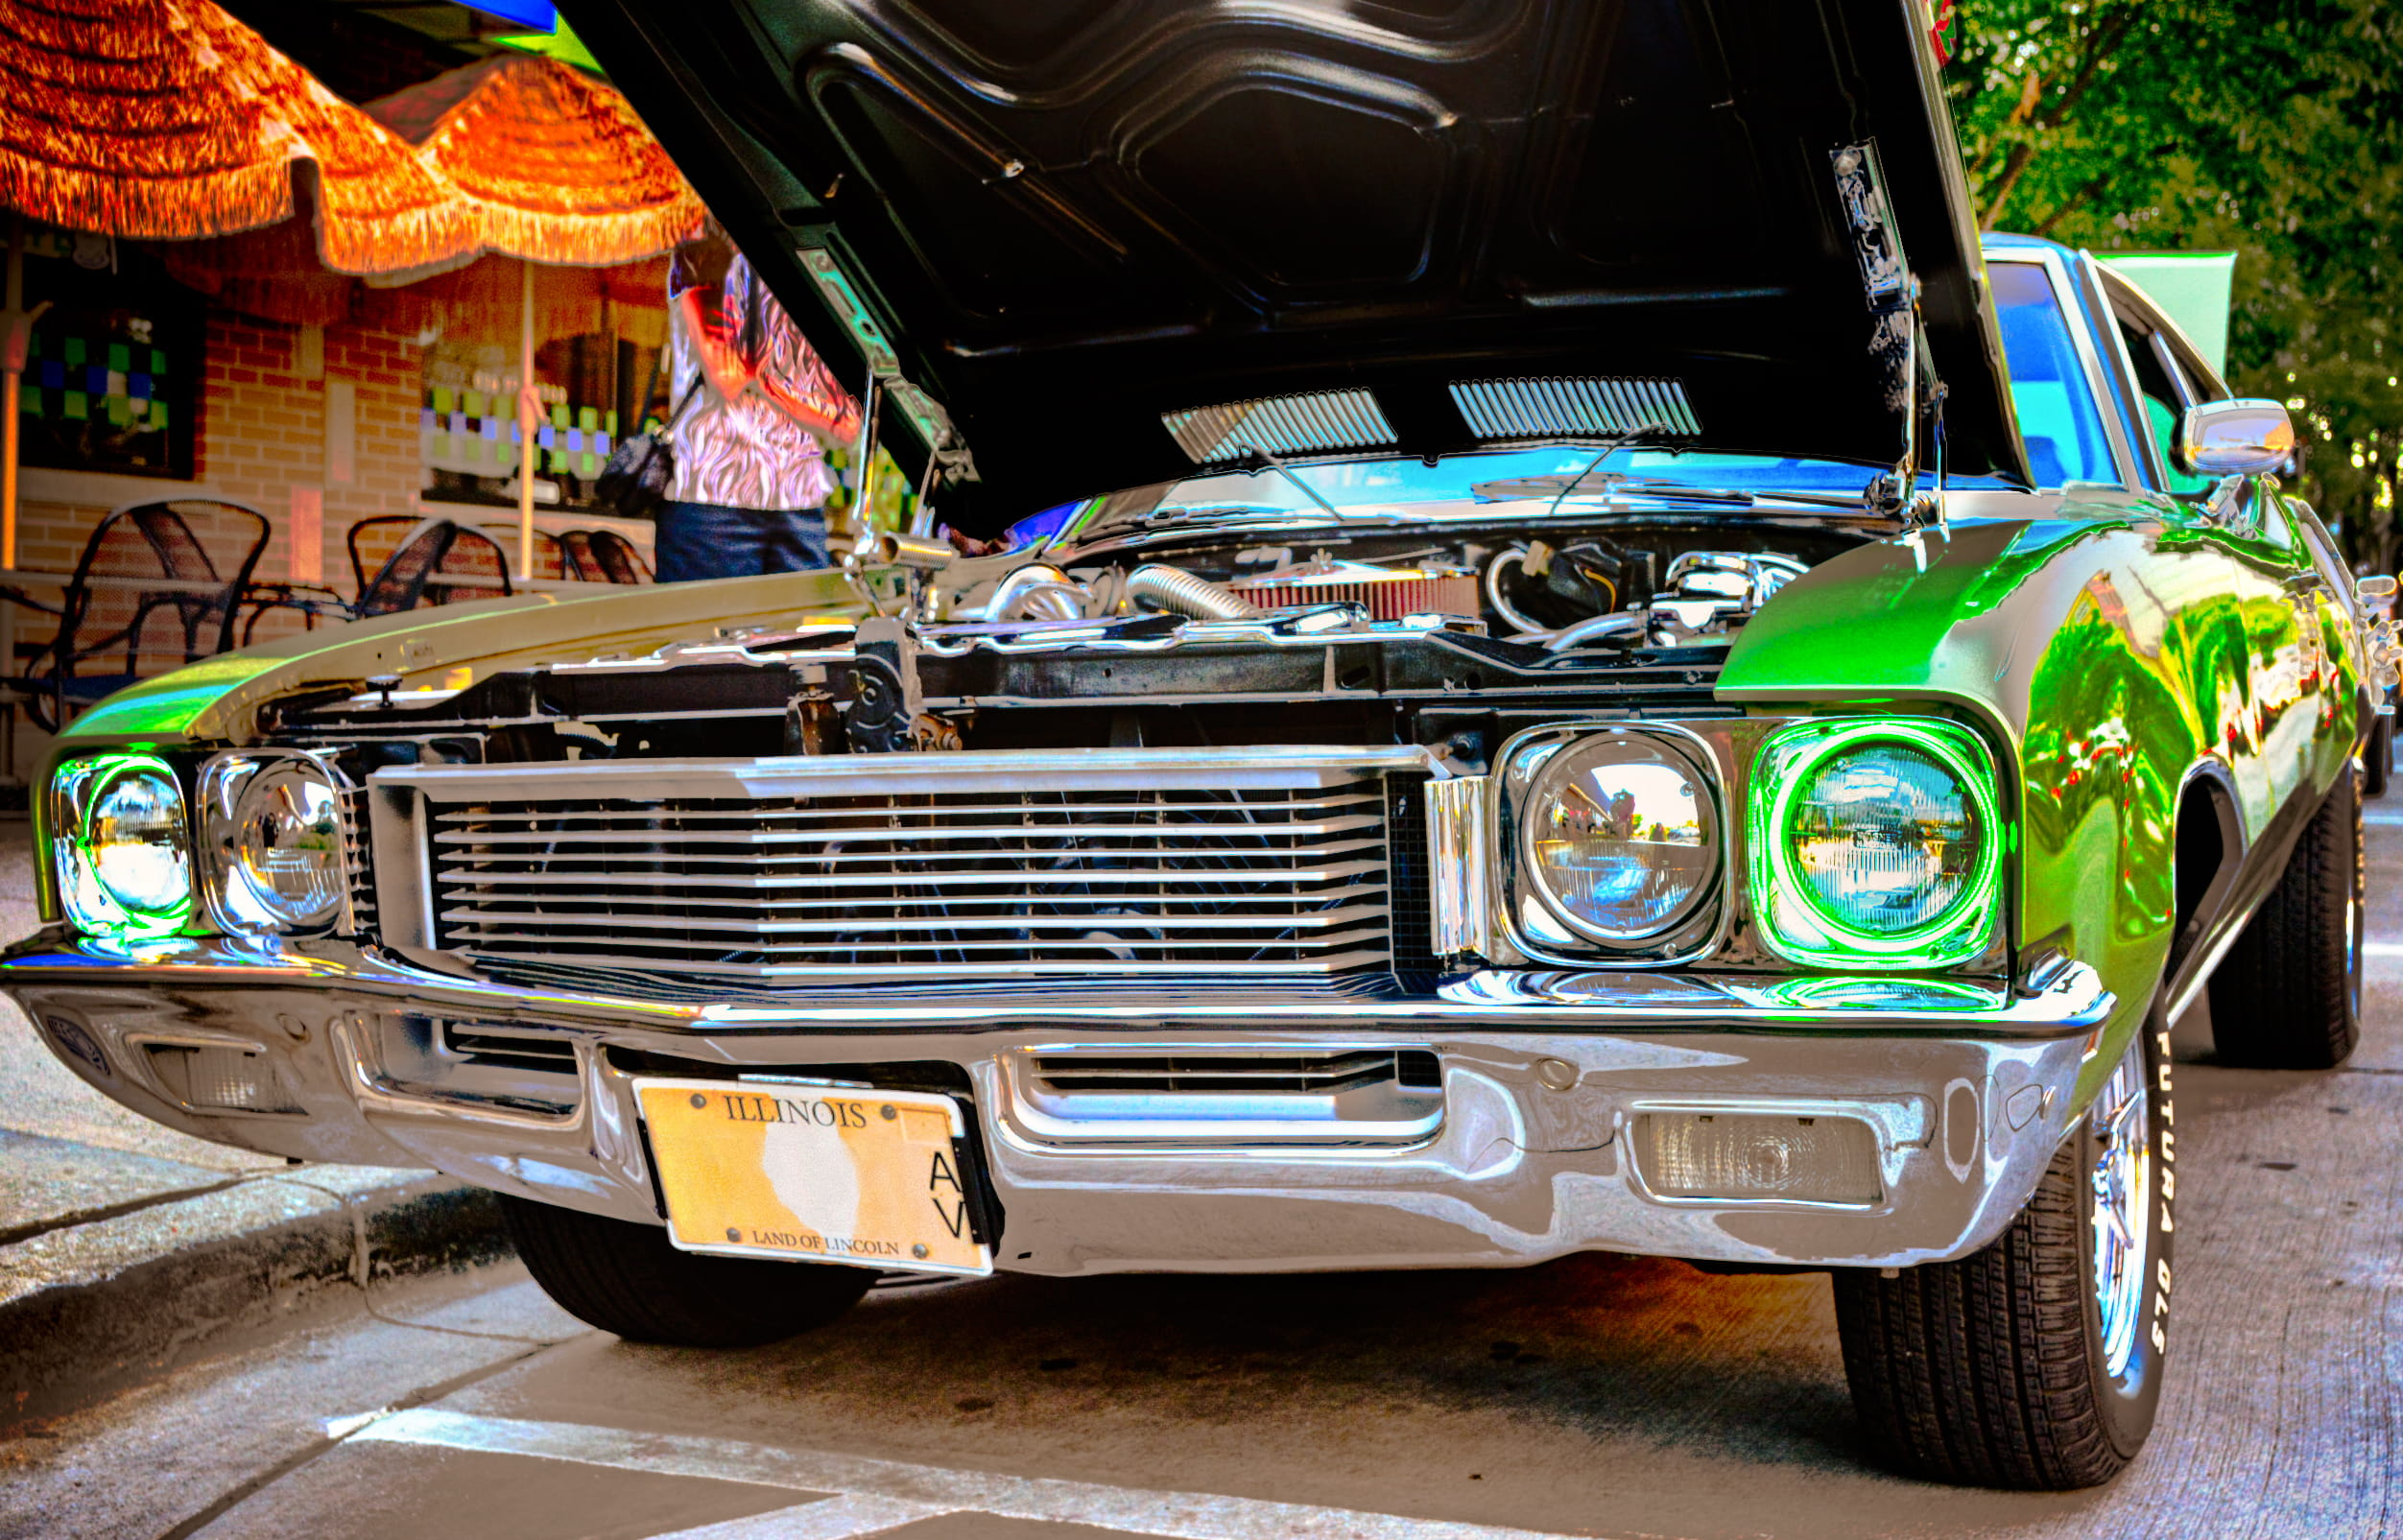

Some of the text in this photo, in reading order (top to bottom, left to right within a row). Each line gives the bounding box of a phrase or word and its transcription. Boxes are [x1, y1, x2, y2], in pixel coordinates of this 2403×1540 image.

[724, 1095, 868, 1129] ILLINOIS
[2151, 1031, 2176, 1355] FUTURA GLS
[752, 1230, 900, 1255] LAND OF LINCOLN
